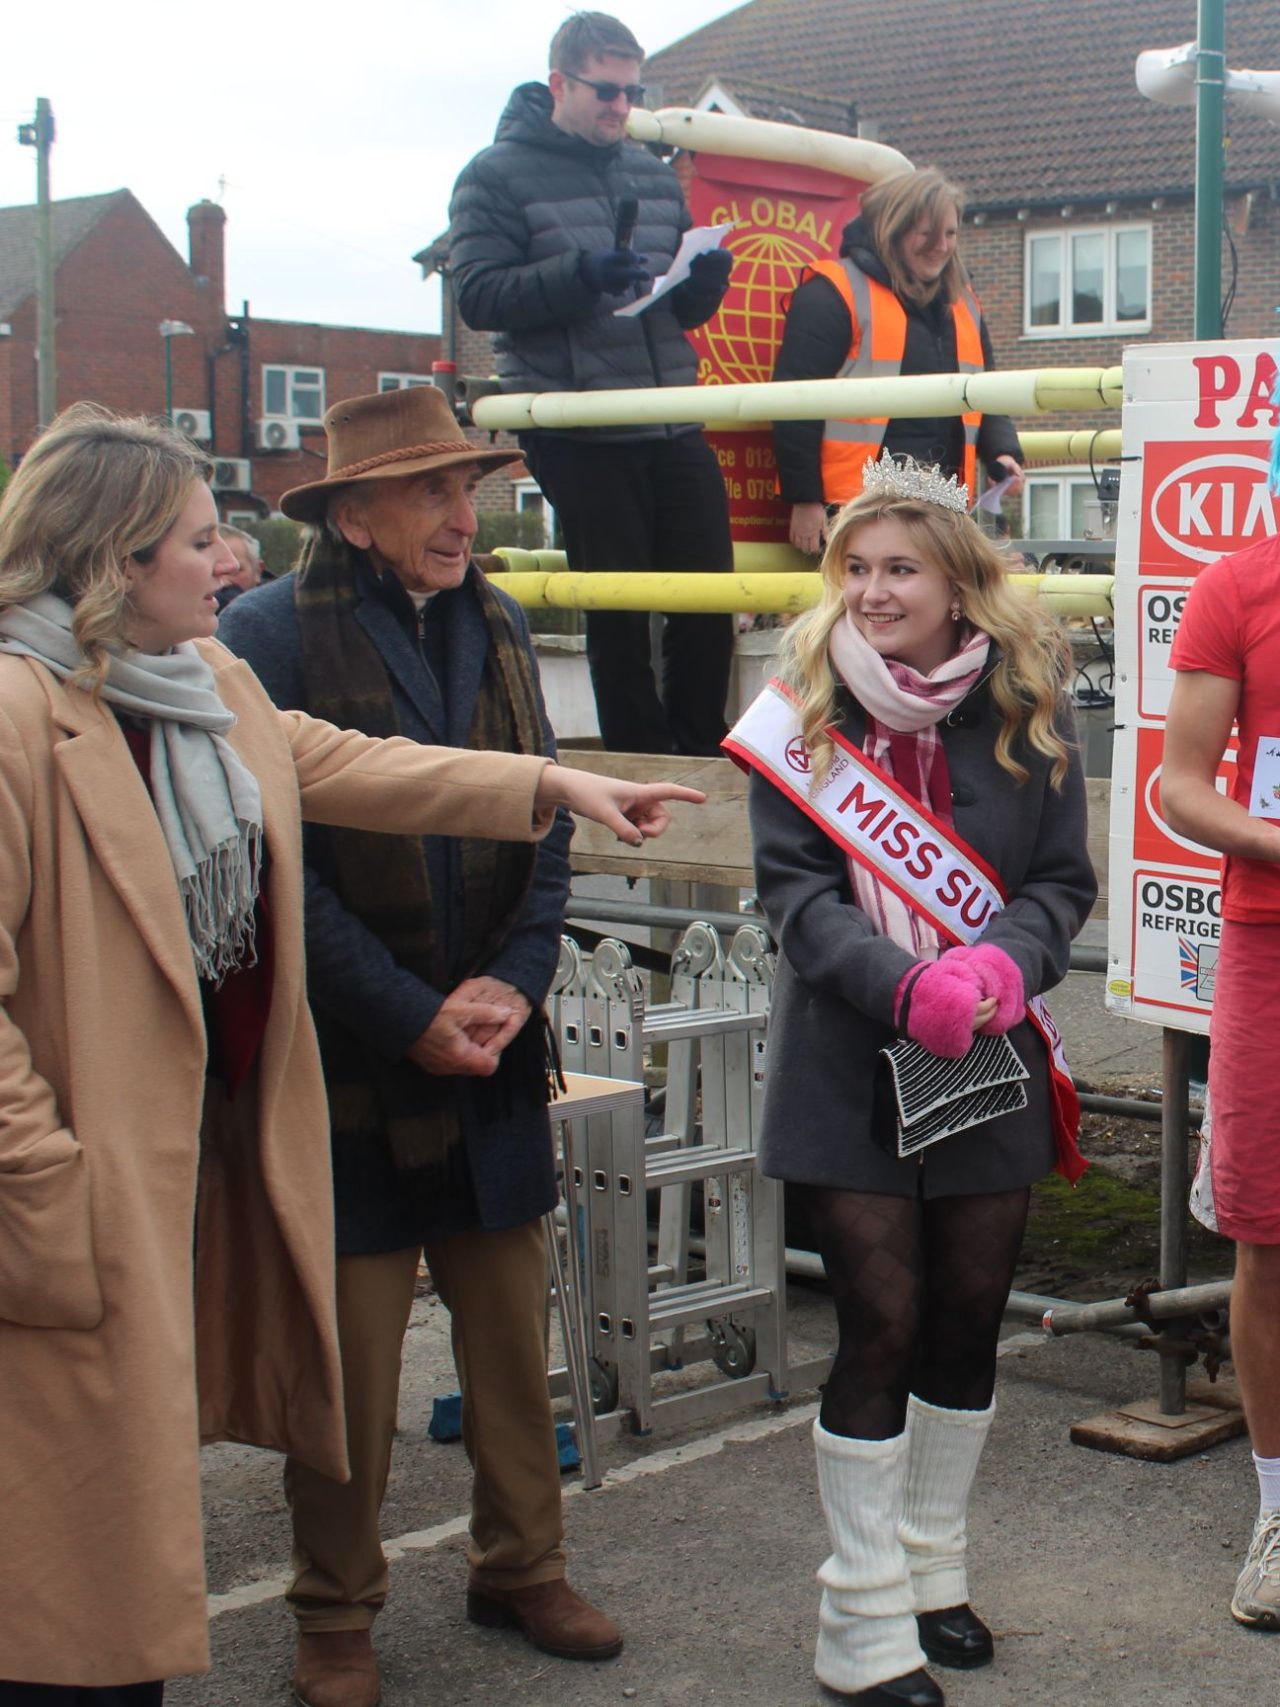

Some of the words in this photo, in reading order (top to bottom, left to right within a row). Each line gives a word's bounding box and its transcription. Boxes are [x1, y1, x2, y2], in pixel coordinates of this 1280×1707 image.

[711, 197, 833, 253] GLOBAL
[1178, 482, 1278, 537] KIA
[836, 781, 943, 880] MISS
[935, 869, 999, 928] SU
[1142, 881, 1221, 918] OSBO
[1142, 913, 1220, 939] REFRIGE
